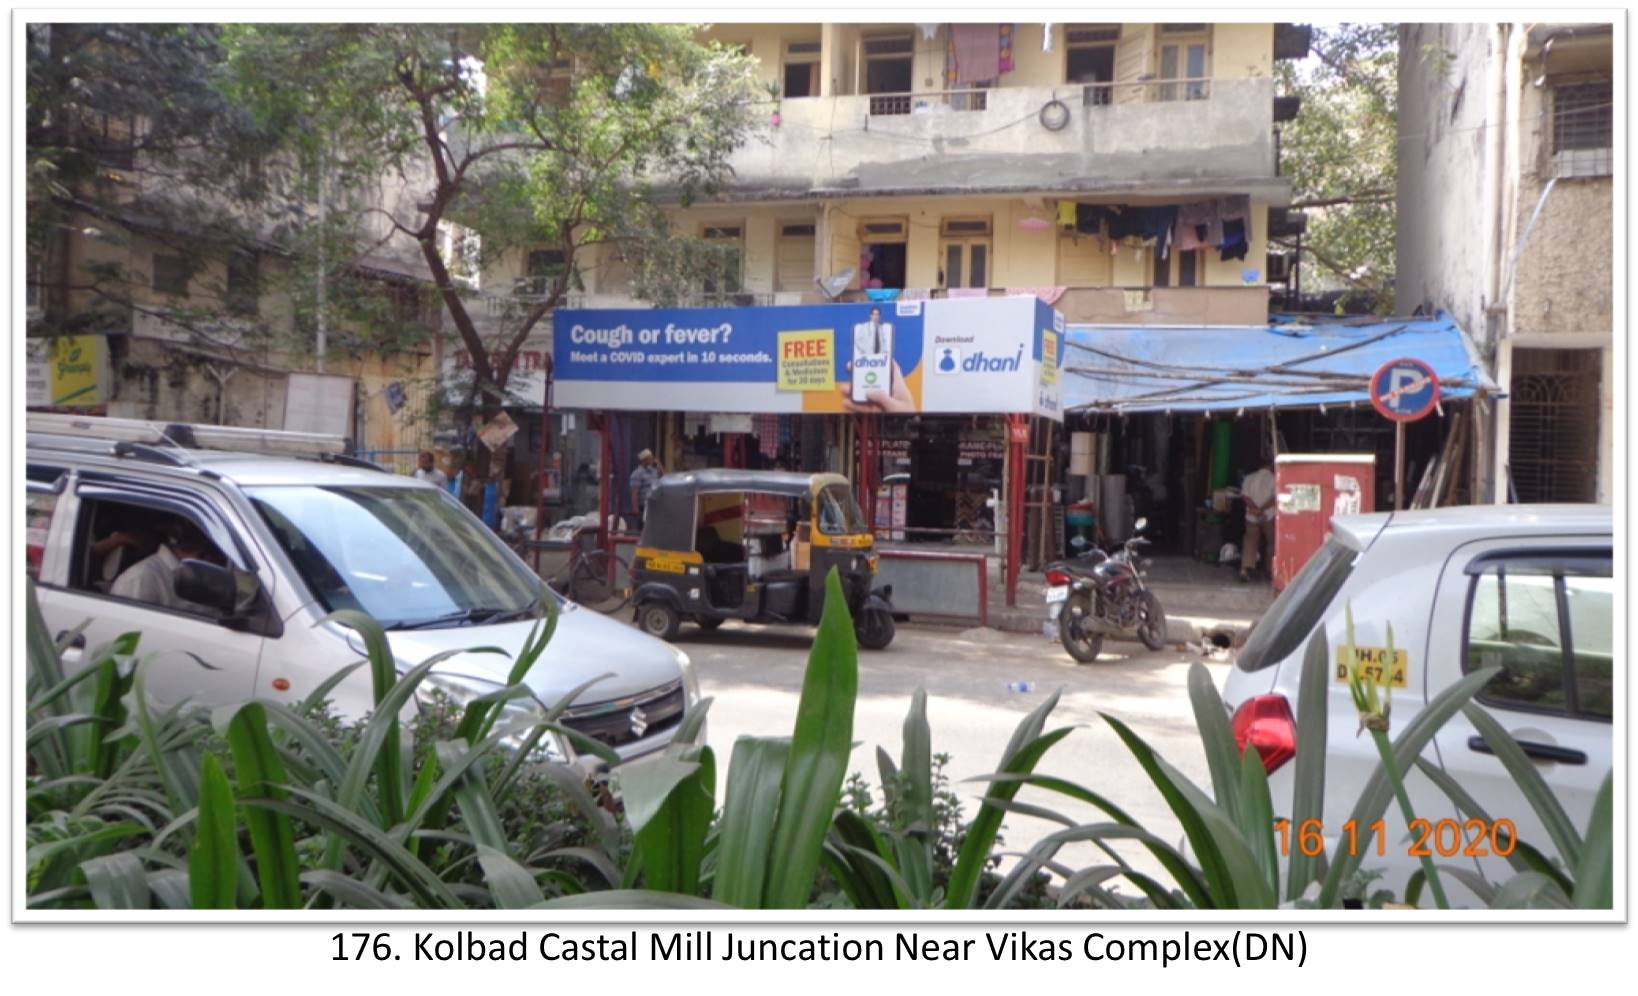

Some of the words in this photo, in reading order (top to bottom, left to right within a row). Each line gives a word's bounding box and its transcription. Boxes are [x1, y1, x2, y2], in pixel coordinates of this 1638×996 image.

[571, 324, 633, 349] Cough
[639, 328, 660, 344] or
[665, 323, 732, 344] fever?
[934, 335, 975, 344] Download
[570, 351, 598, 363] Meet
[600, 354, 608, 362] a
[610, 351, 645, 363] COVID
[647, 352, 684, 365] expert
[686, 351, 699, 363] in
[701, 351, 716, 362] 10
[718, 350, 773, 363] seconds.
[783, 338, 828, 359] FREE
[962, 343, 1025, 372] dhani
[855, 353, 888, 368] dhani
[1389, 368, 1425, 408] P
